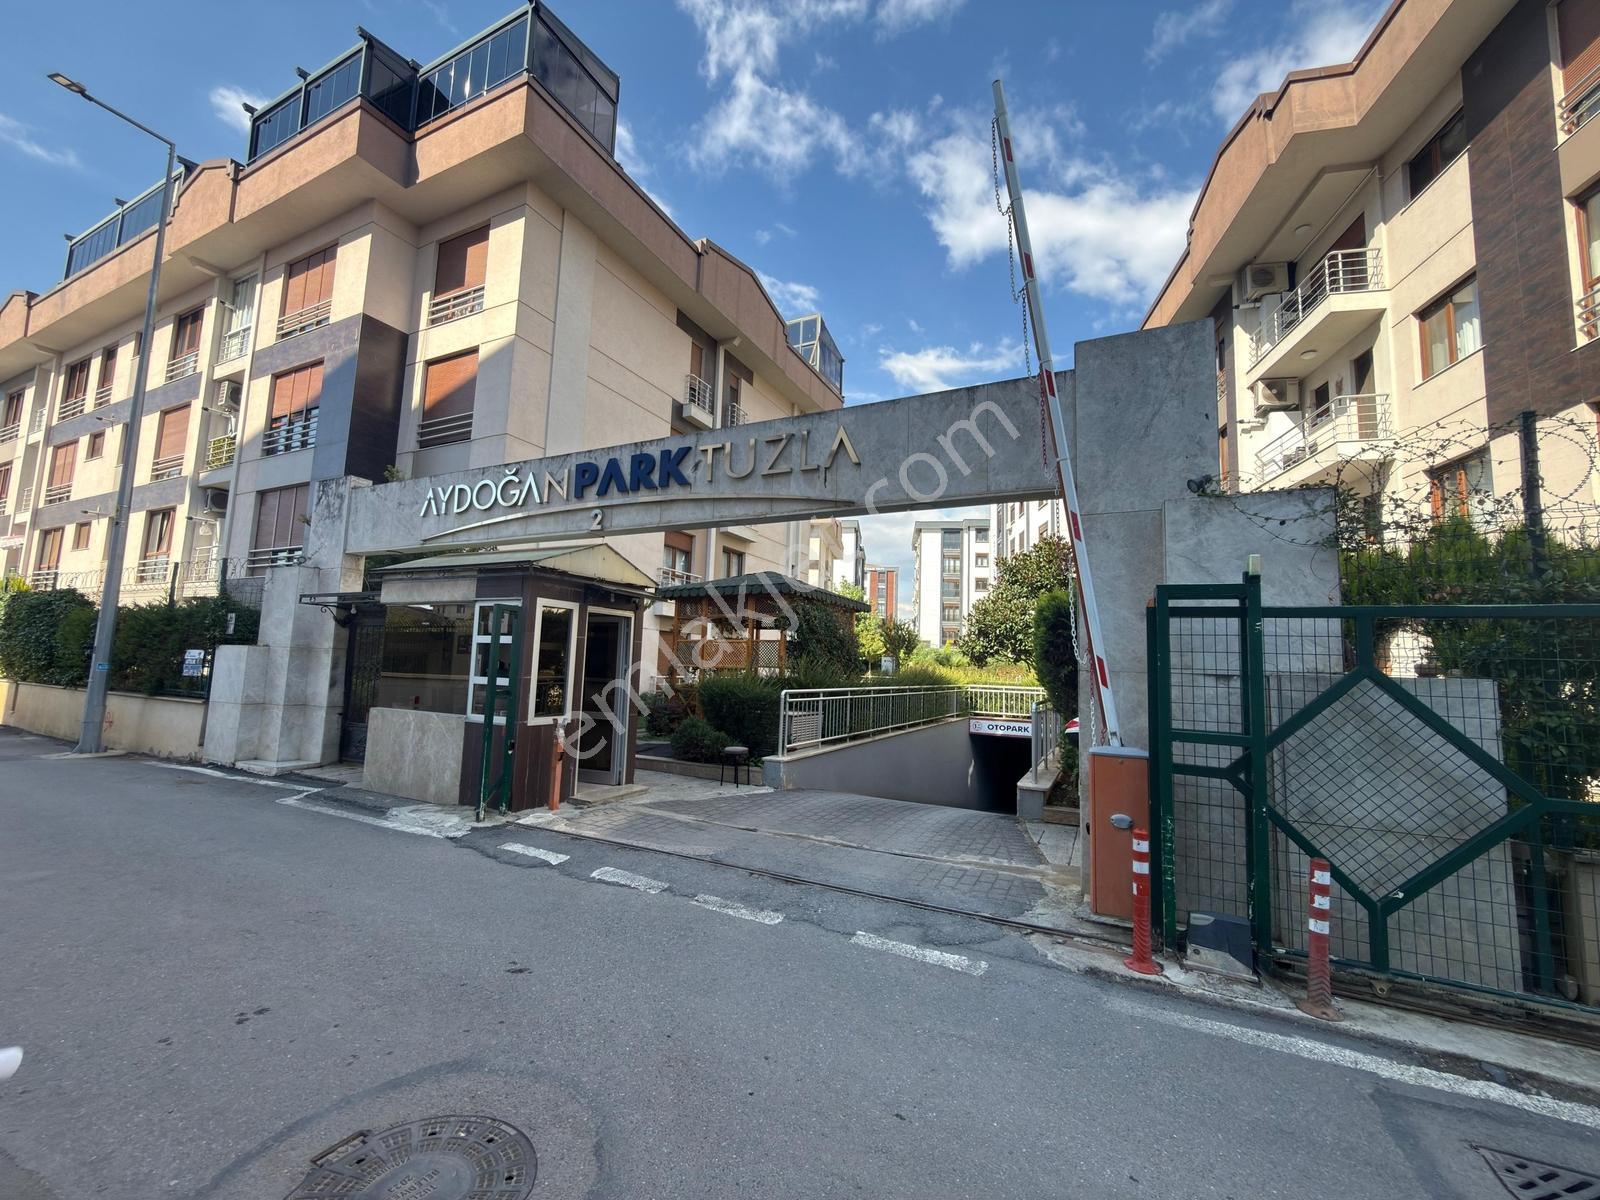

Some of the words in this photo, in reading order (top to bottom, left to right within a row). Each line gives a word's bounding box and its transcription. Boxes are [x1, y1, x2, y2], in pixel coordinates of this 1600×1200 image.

[700, 424, 861, 483] TUZLA
[589, 510, 604, 532] 2
[987, 723, 1030, 734] OTOPARK
[405, 1185, 437, 1200] TUZL
